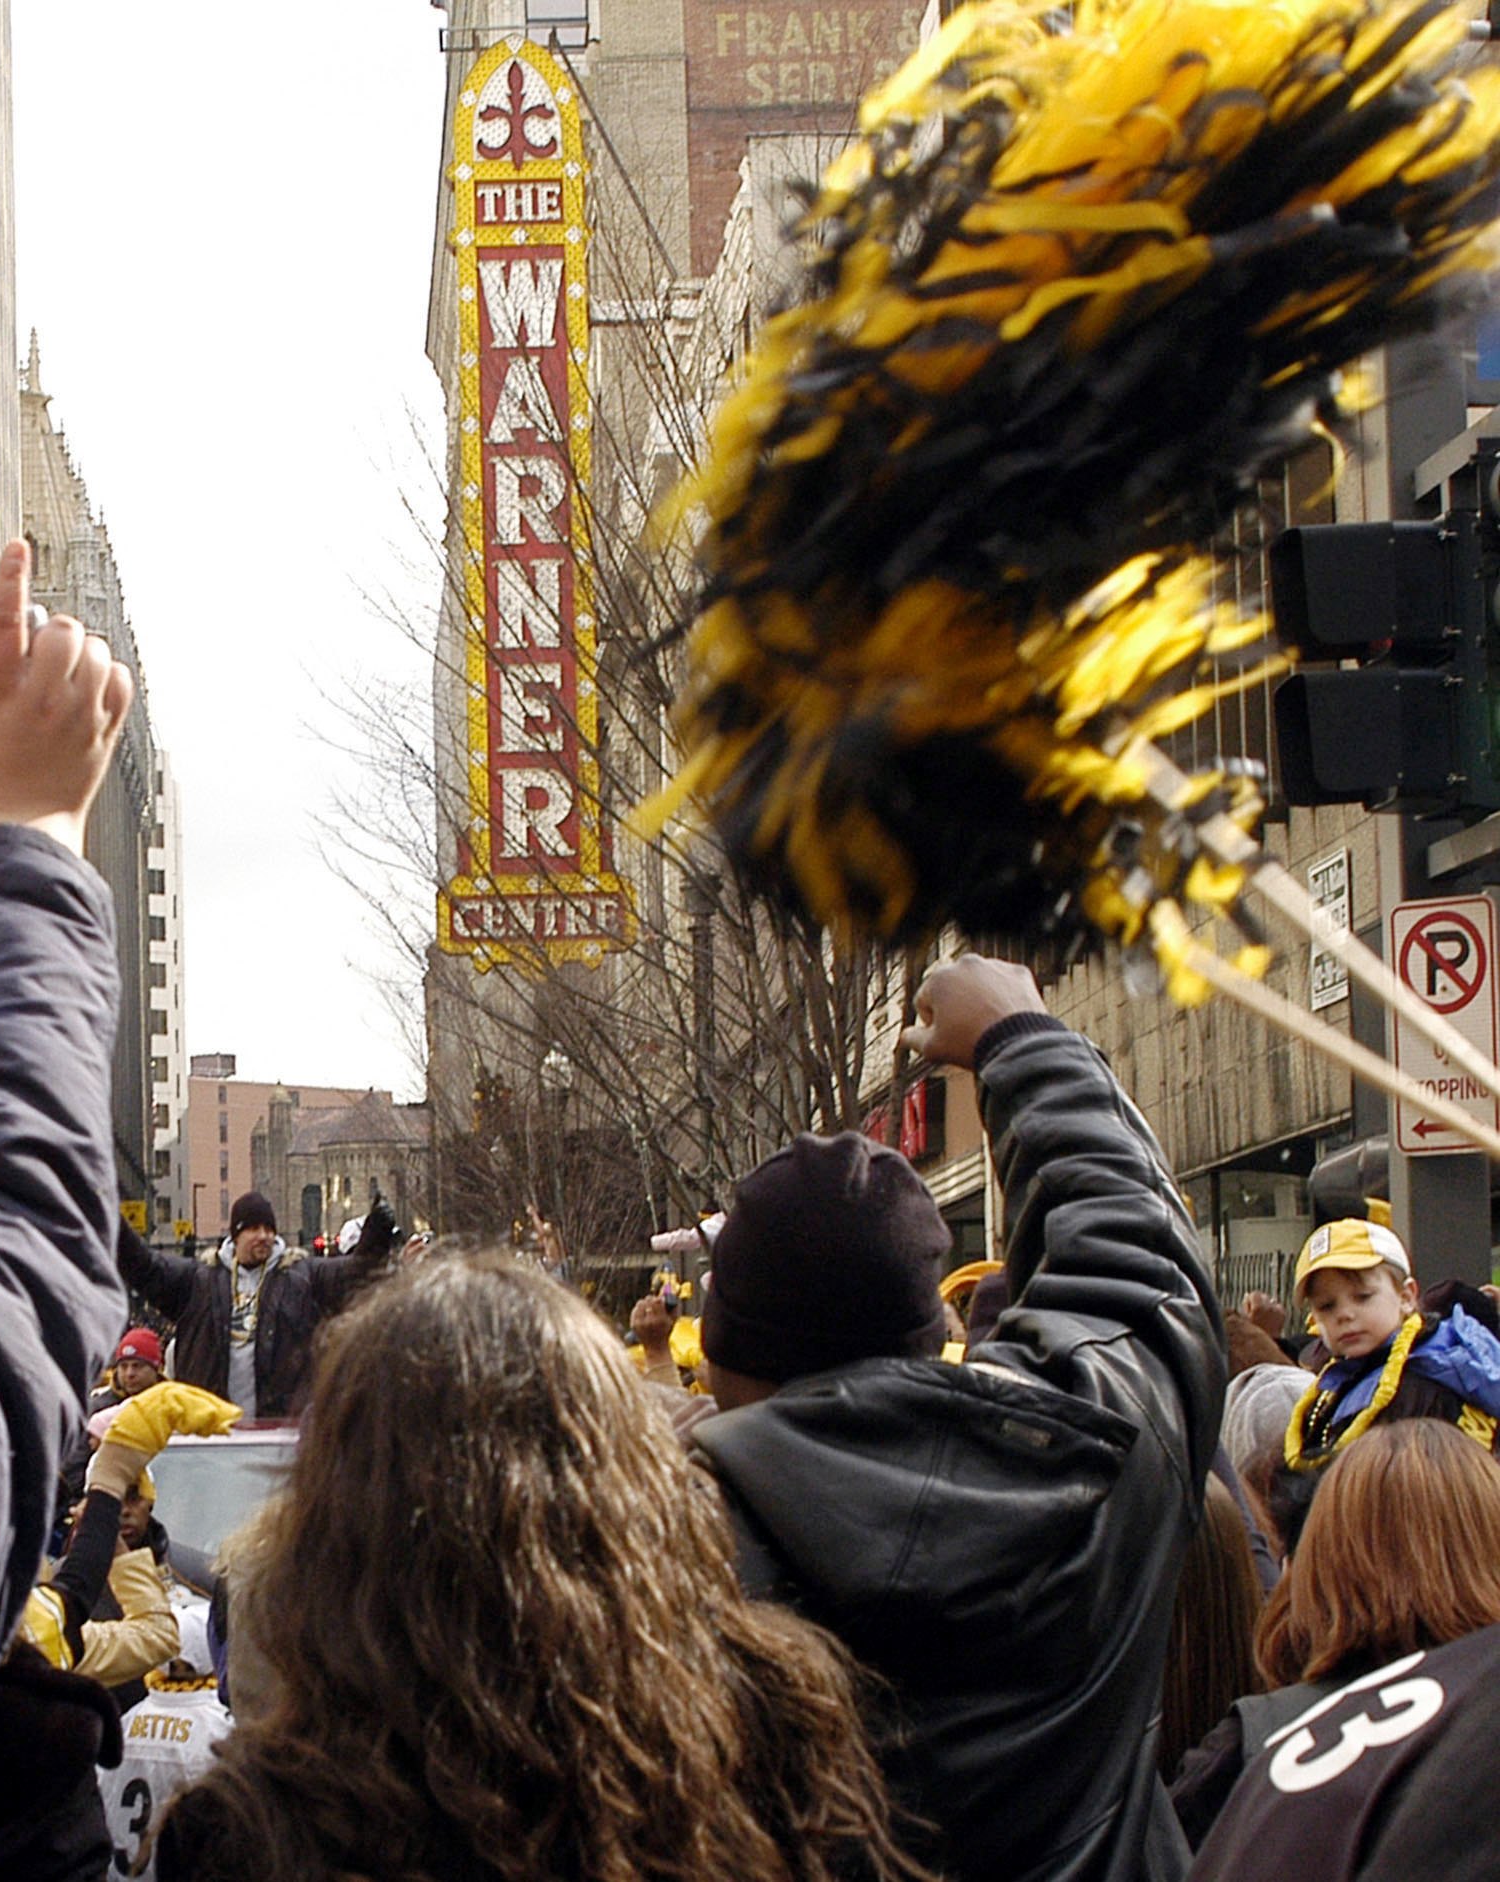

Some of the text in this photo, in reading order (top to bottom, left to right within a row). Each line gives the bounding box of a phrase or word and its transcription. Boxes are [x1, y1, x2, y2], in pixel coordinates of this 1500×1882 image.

[715, 10, 876, 58] FRANK
[477, 182, 562, 223] THE
[477, 257, 577, 858] WARNER
[452, 898, 620, 938] CENTRE
[128, 1713, 193, 1744] BETTIS
